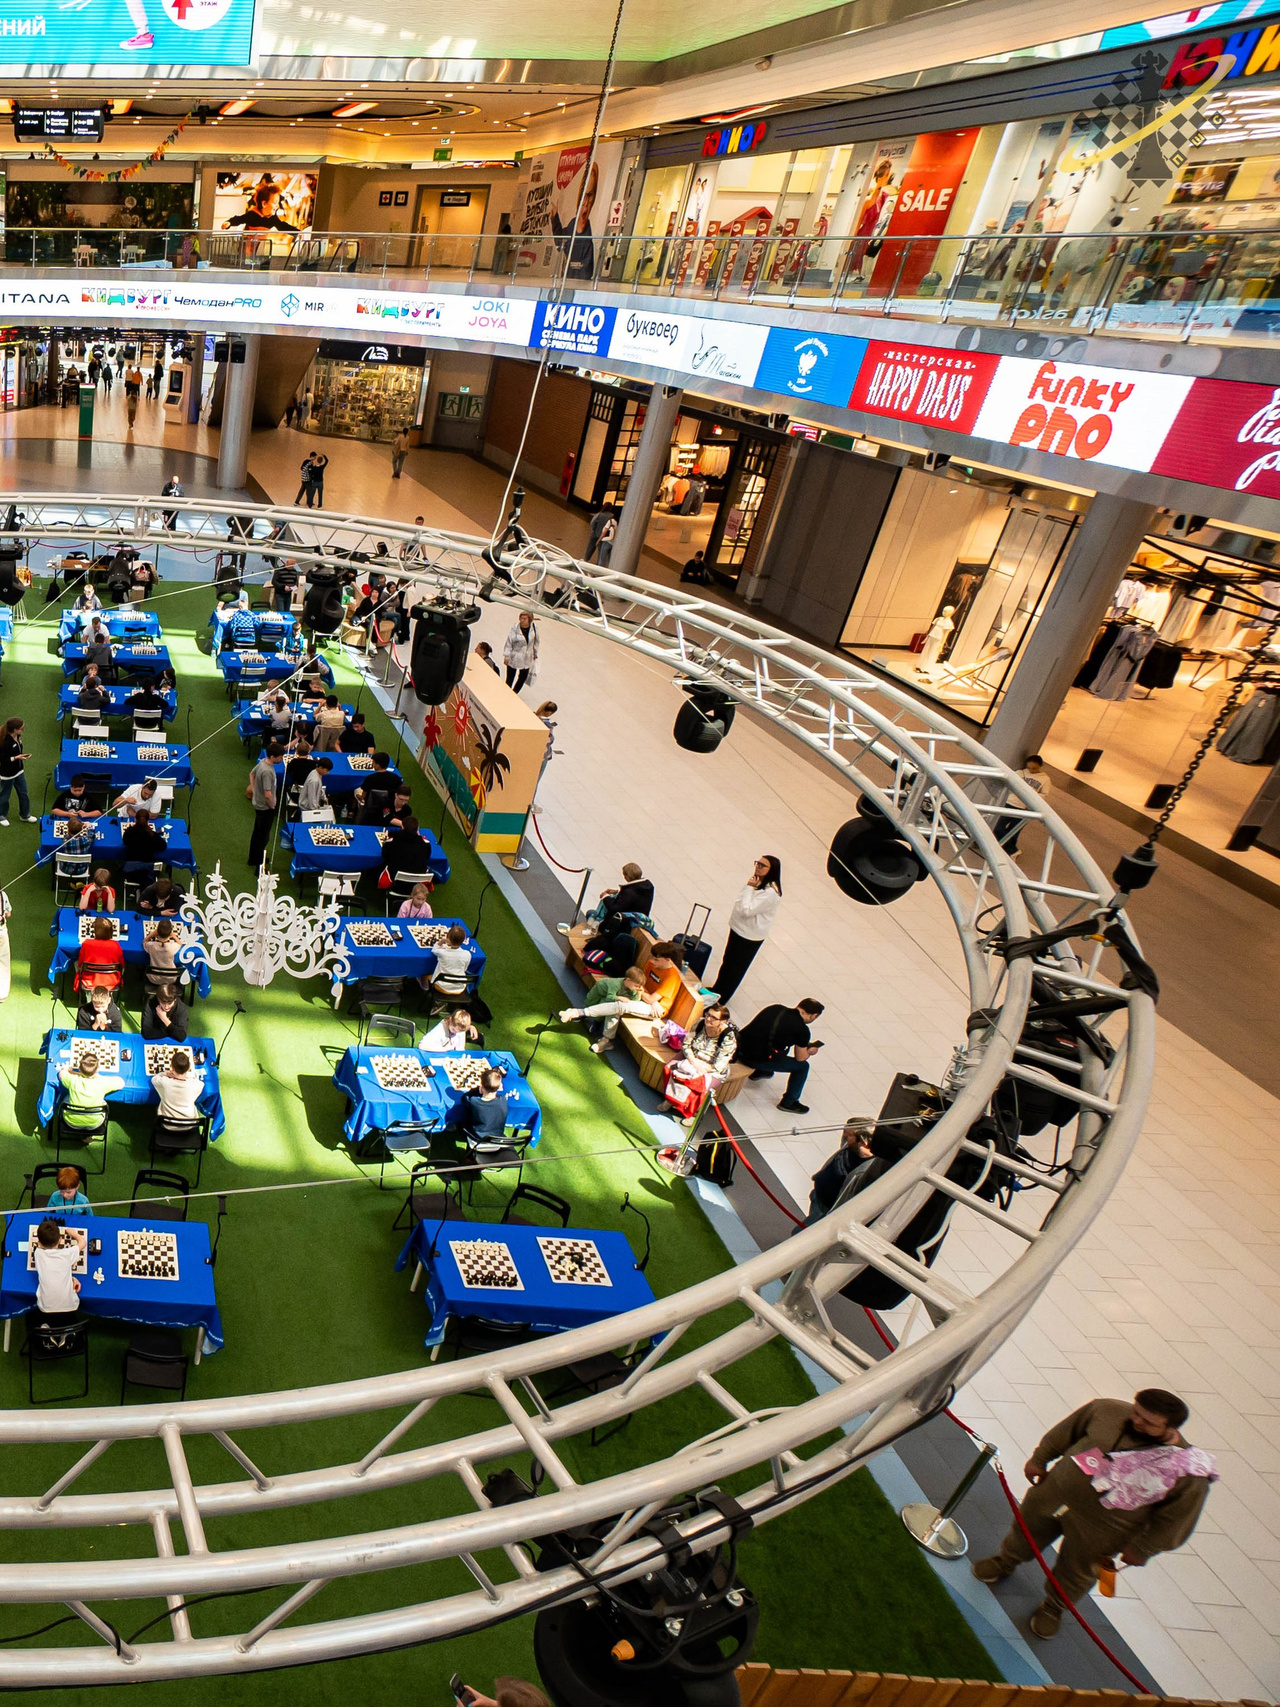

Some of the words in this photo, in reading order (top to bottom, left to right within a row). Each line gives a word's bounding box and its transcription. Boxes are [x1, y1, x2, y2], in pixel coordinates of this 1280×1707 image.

[702, 121, 766, 158] ЮНИОР
[899, 188, 953, 212] SALE
[1, 293, 70, 304] ITANA
[81, 287, 172, 306] КИДБУРГ
[174, 295, 262, 308] ЧемоданPRO
[472, 300, 510, 313] JOKI
[356, 297, 446, 319] КИДБУРГ
[468, 316, 507, 329] JOYA
[543, 303, 606, 334] КИНО
[577, 334, 600, 345] ПАРК
[626, 313, 679, 346] буквоед
[886, 350, 972, 369] мастерская
[865, 362, 924, 411] HAPPY
[916, 369, 973, 421] DAYS
[1028, 361, 1135, 412] funky
